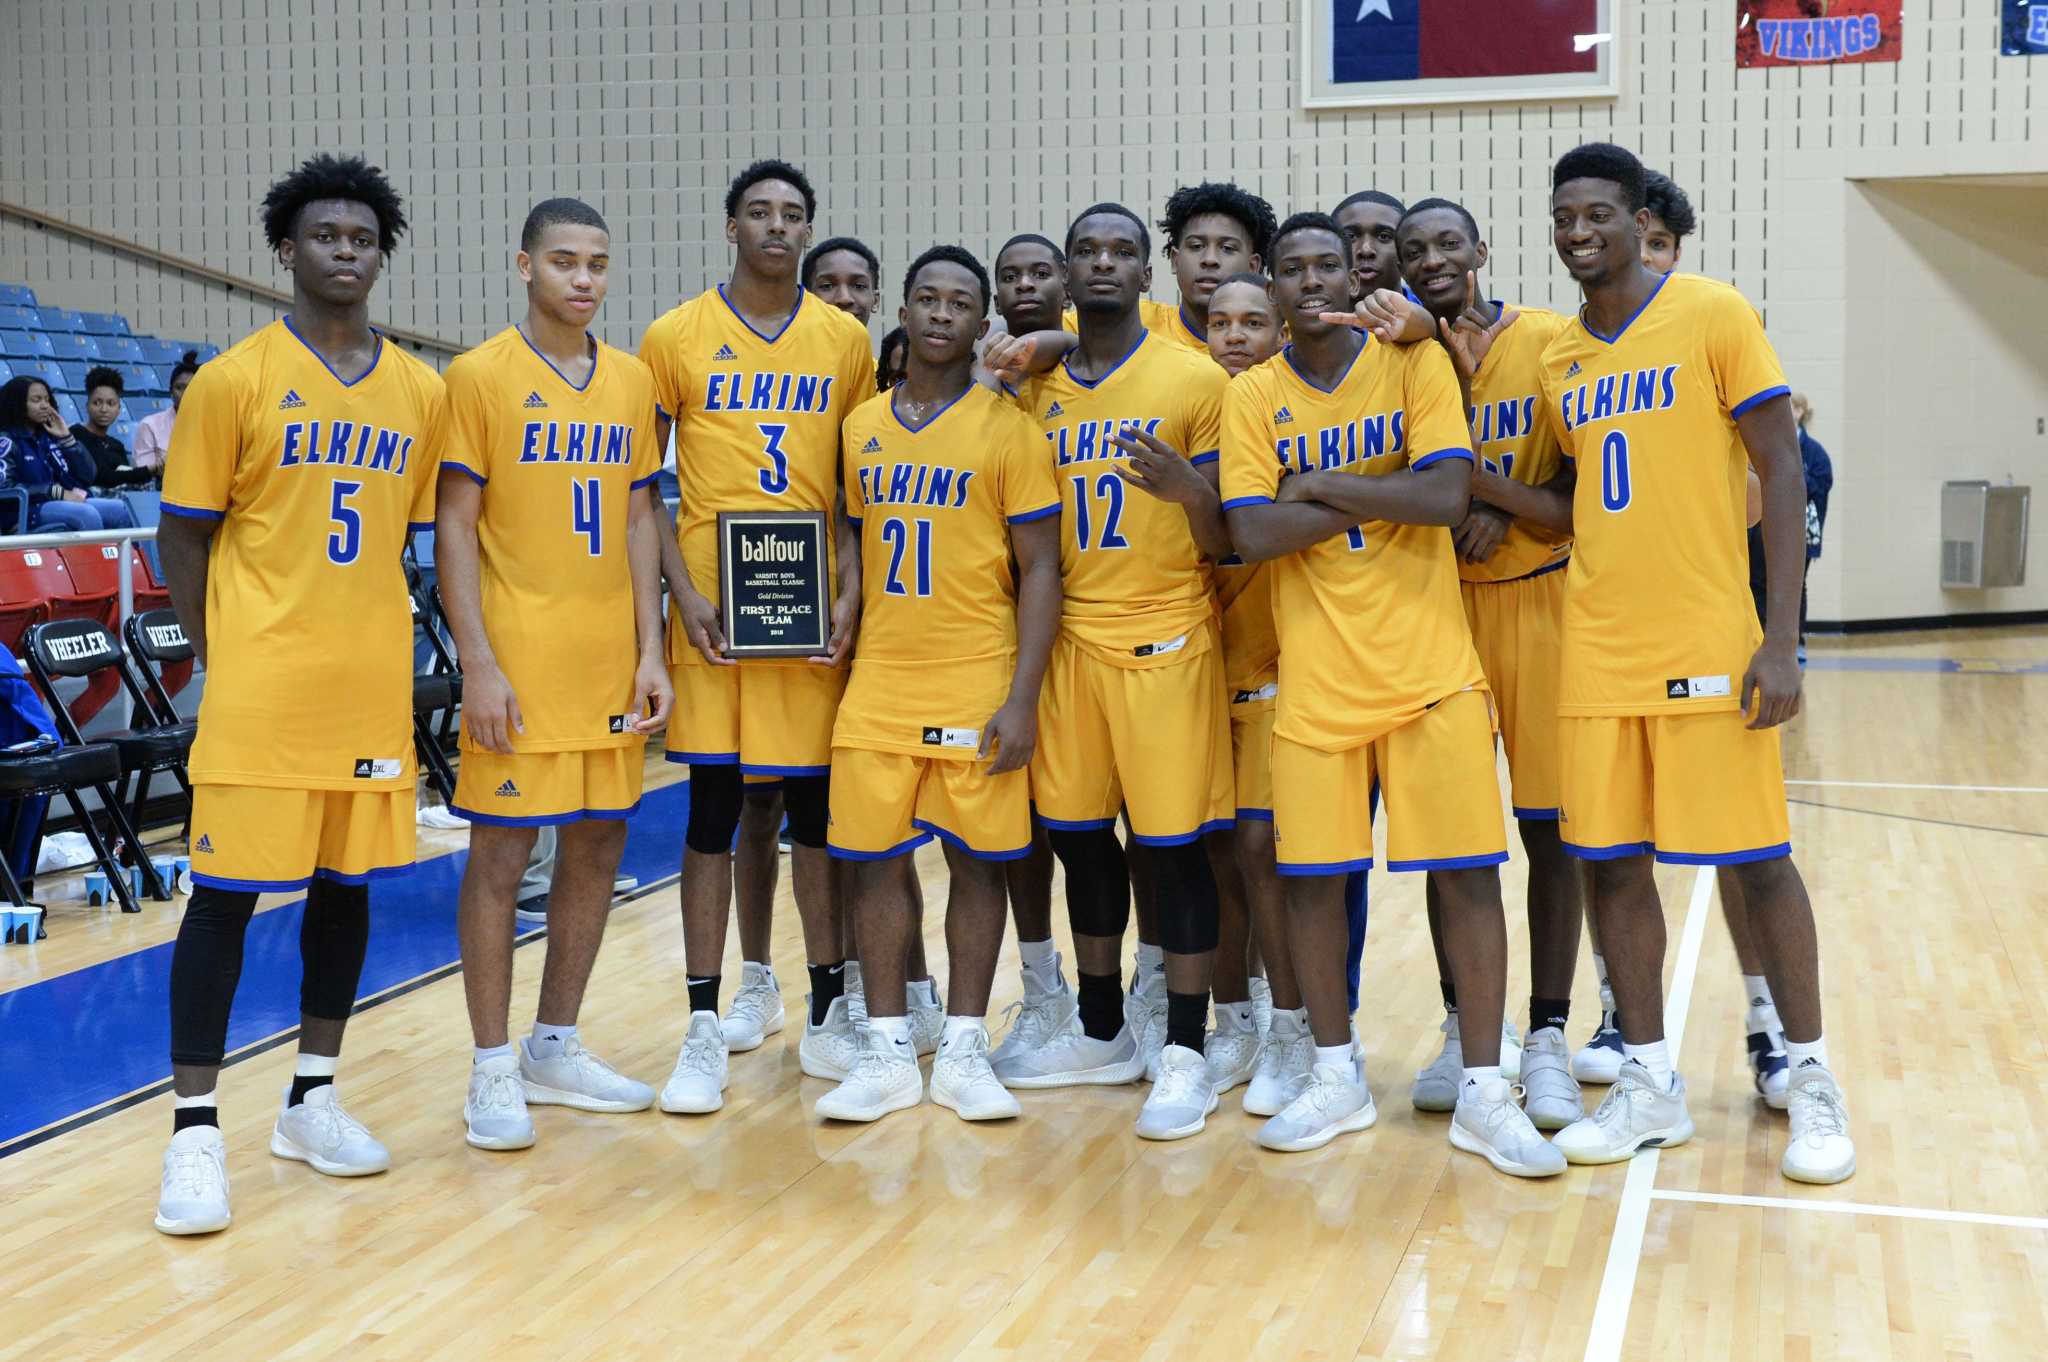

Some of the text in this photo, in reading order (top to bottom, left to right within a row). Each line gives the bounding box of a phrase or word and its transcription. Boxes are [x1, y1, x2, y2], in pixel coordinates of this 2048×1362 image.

[1757, 14, 1881, 60] VIKINGS
[703, 372, 838, 415] ELKINS
[1561, 364, 1681, 433] ELKINS
[277, 419, 415, 477] ELKINS
[517, 421, 634, 465] ELKINS
[756, 422, 790, 495] 3
[1276, 409, 1405, 475] ELKINS
[858, 462, 976, 509] ELKINS
[1602, 428, 1632, 513] 0
[327, 478, 363, 566] 5
[571, 477, 602, 557] 4
[1068, 472, 1131, 552] 12
[741, 533, 805, 562] balfour
[881, 516, 933, 598] 21
[740, 605, 812, 615] FIRST PLACE
[757, 592, 794, 600] Gold Division
[760, 615, 793, 625] TEAM
[45, 631, 112, 662] WHEELER
